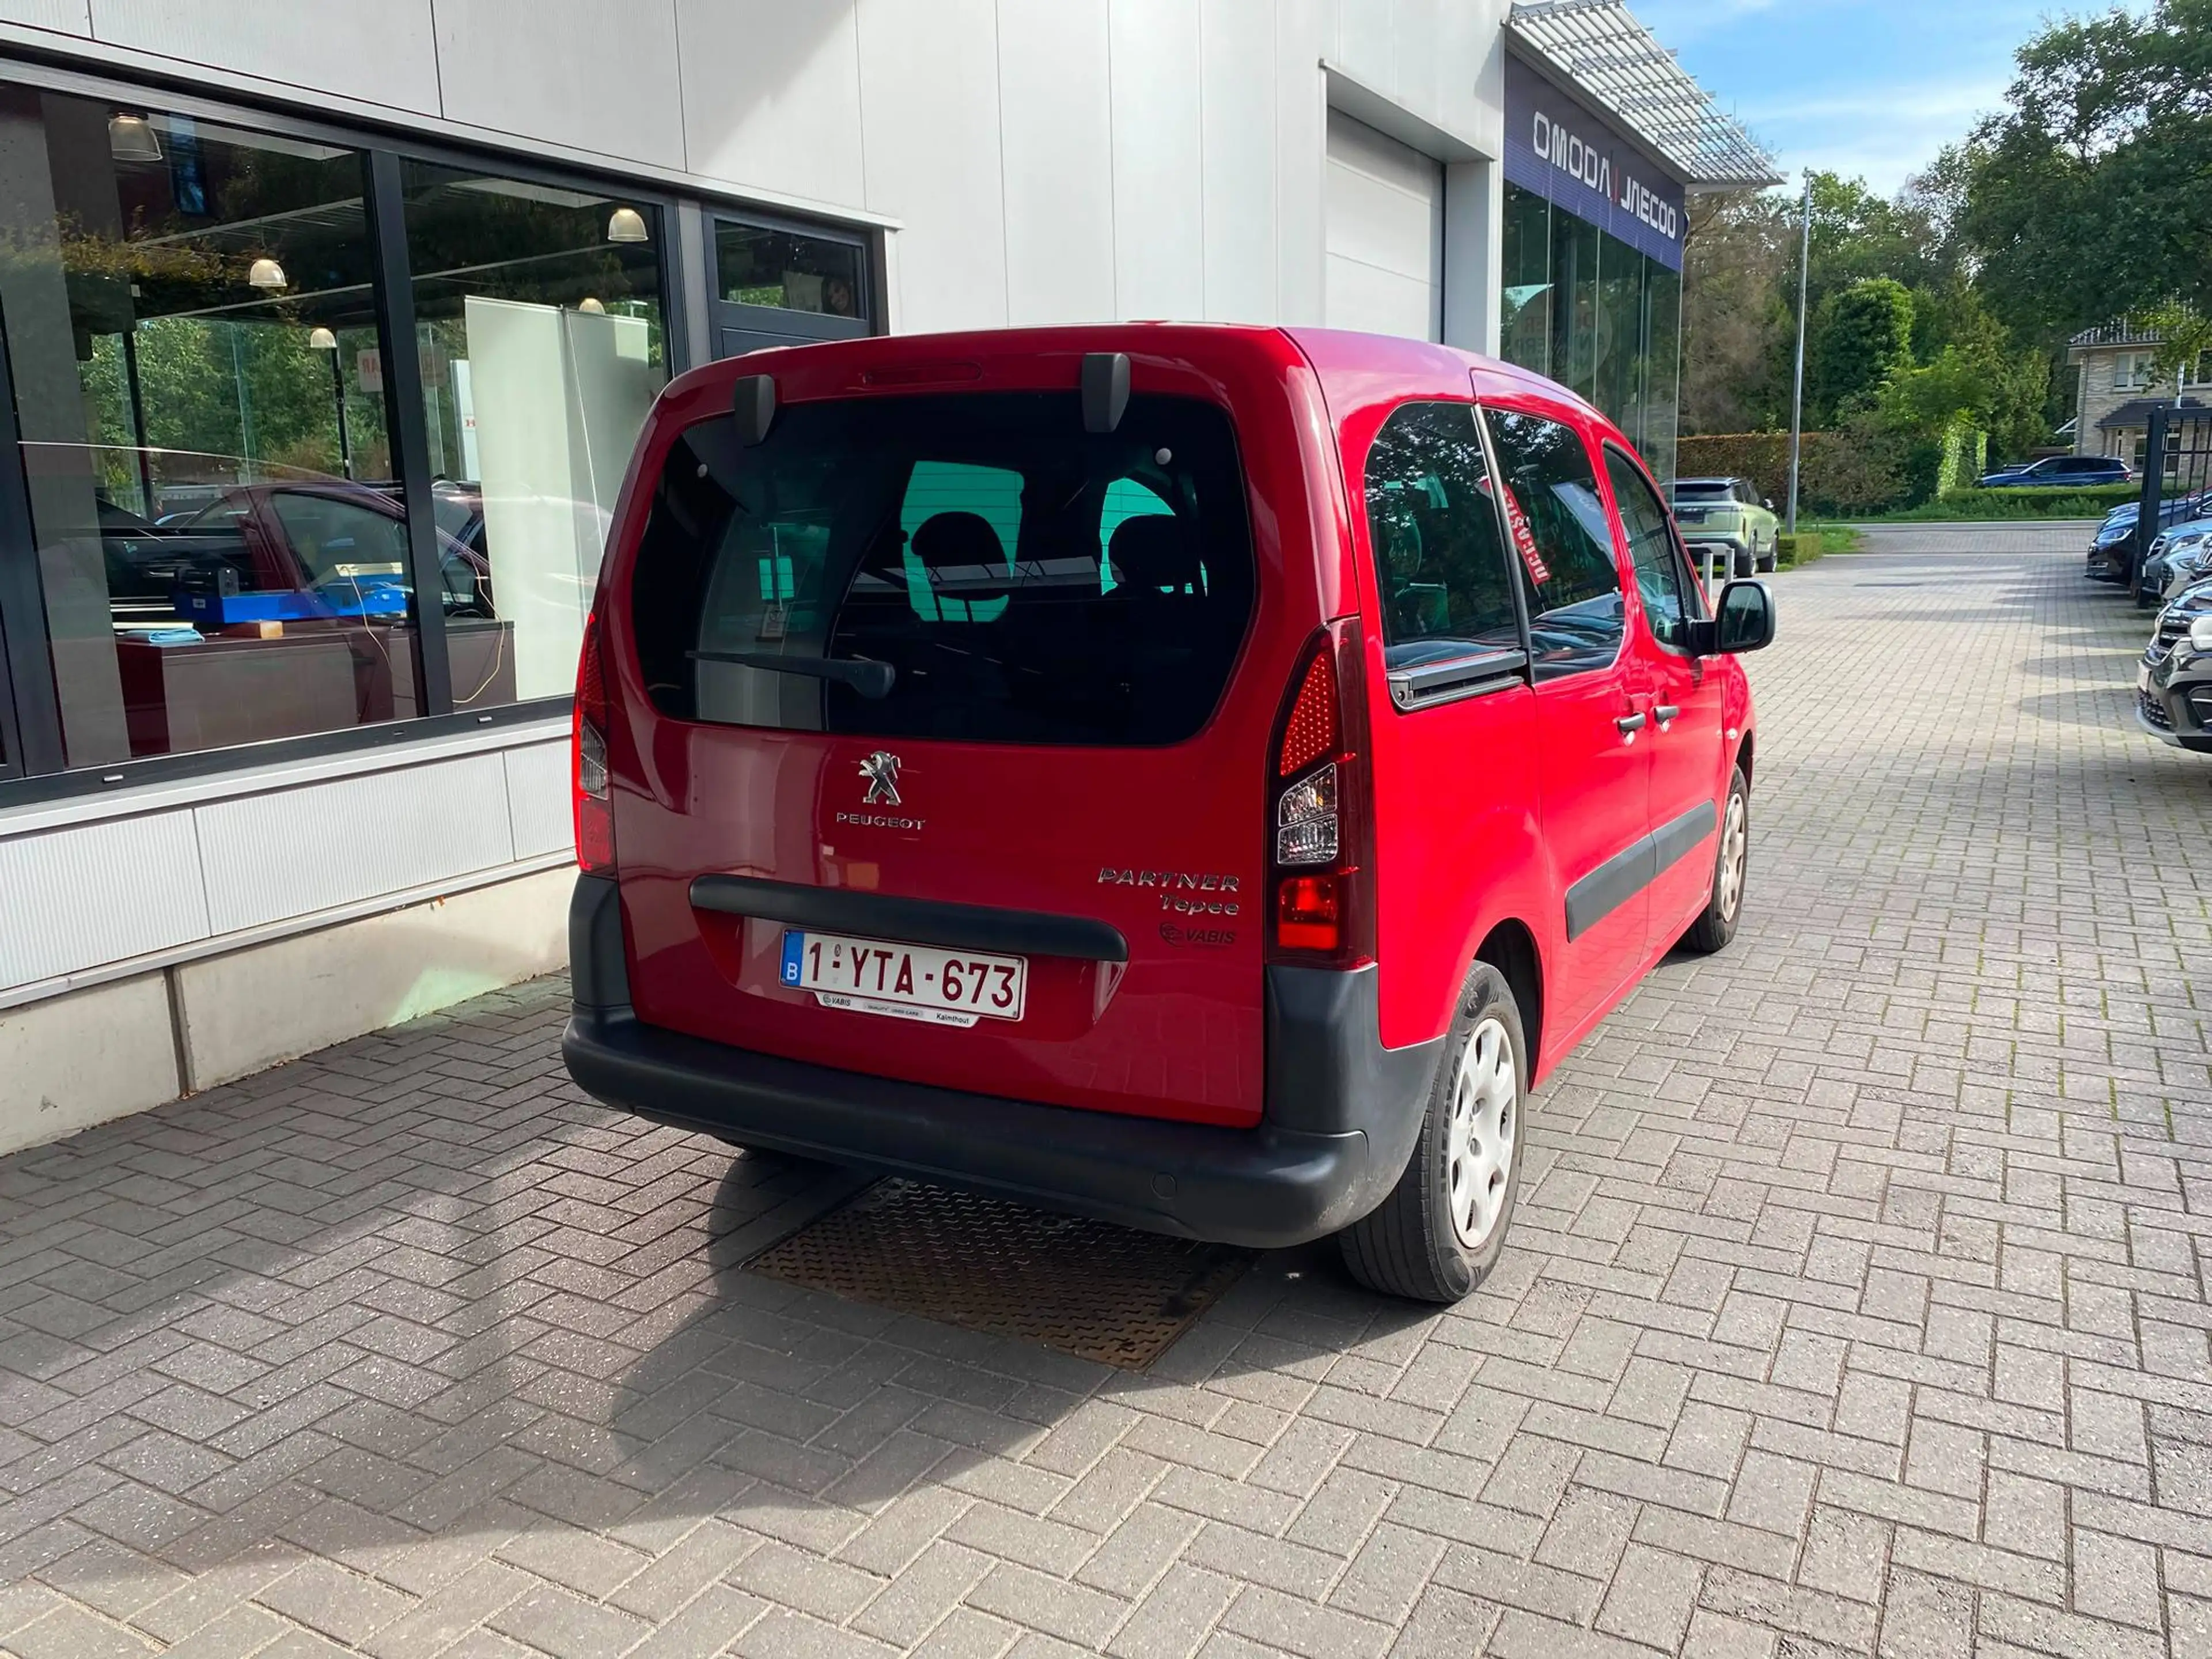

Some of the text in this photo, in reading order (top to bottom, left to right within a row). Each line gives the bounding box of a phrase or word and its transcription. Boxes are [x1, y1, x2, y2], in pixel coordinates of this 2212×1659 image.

[1533, 110, 1676, 240] OMODA JAECOO
[837, 812, 926, 830] PEUGEOT
[1097, 868, 1239, 892] PARTNER
[1160, 894, 1239, 915] Tepee
[1184, 927, 1237, 944] VABIS
[786, 942, 1016, 1009] B 1-YTA-673
[831, 997, 851, 1007] VABIS
[935, 1012, 969, 1025] Kalmthout
